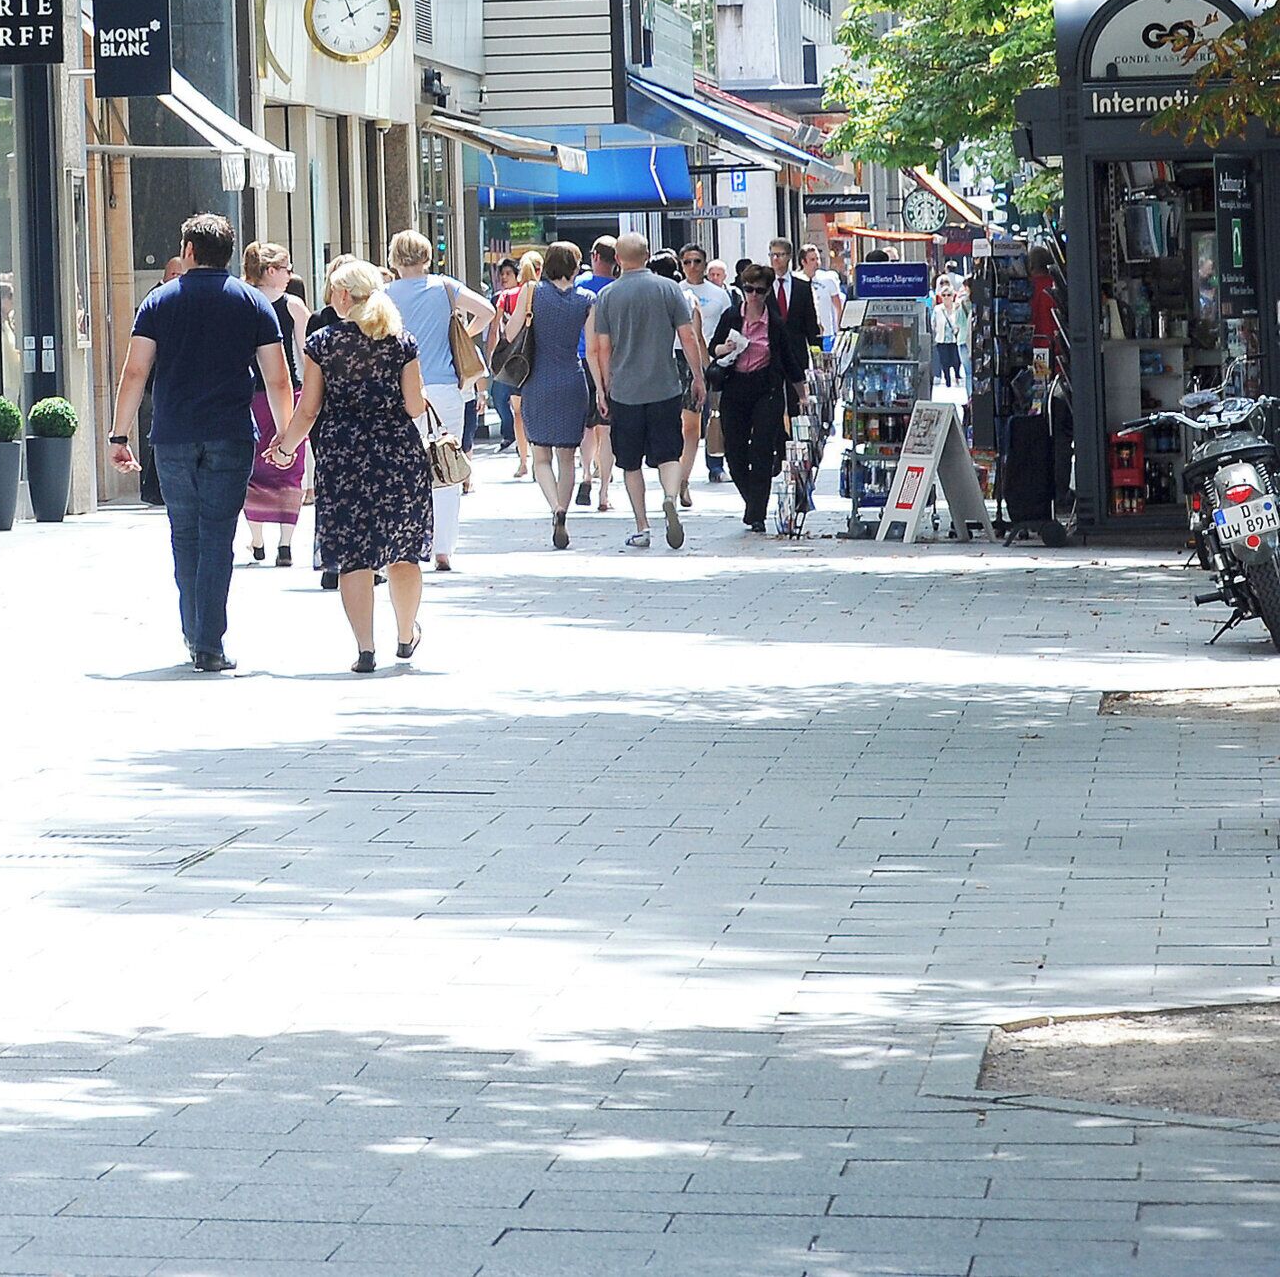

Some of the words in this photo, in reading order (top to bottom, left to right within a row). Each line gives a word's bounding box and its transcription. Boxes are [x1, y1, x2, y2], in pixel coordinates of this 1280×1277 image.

[99, 27, 150, 43] MONT
[100, 41, 150, 58] BLANC
[1114, 53, 1150, 65] CONDÉ
[1240, 504, 1251, 519] D
[1221, 522, 1242, 540] UW
